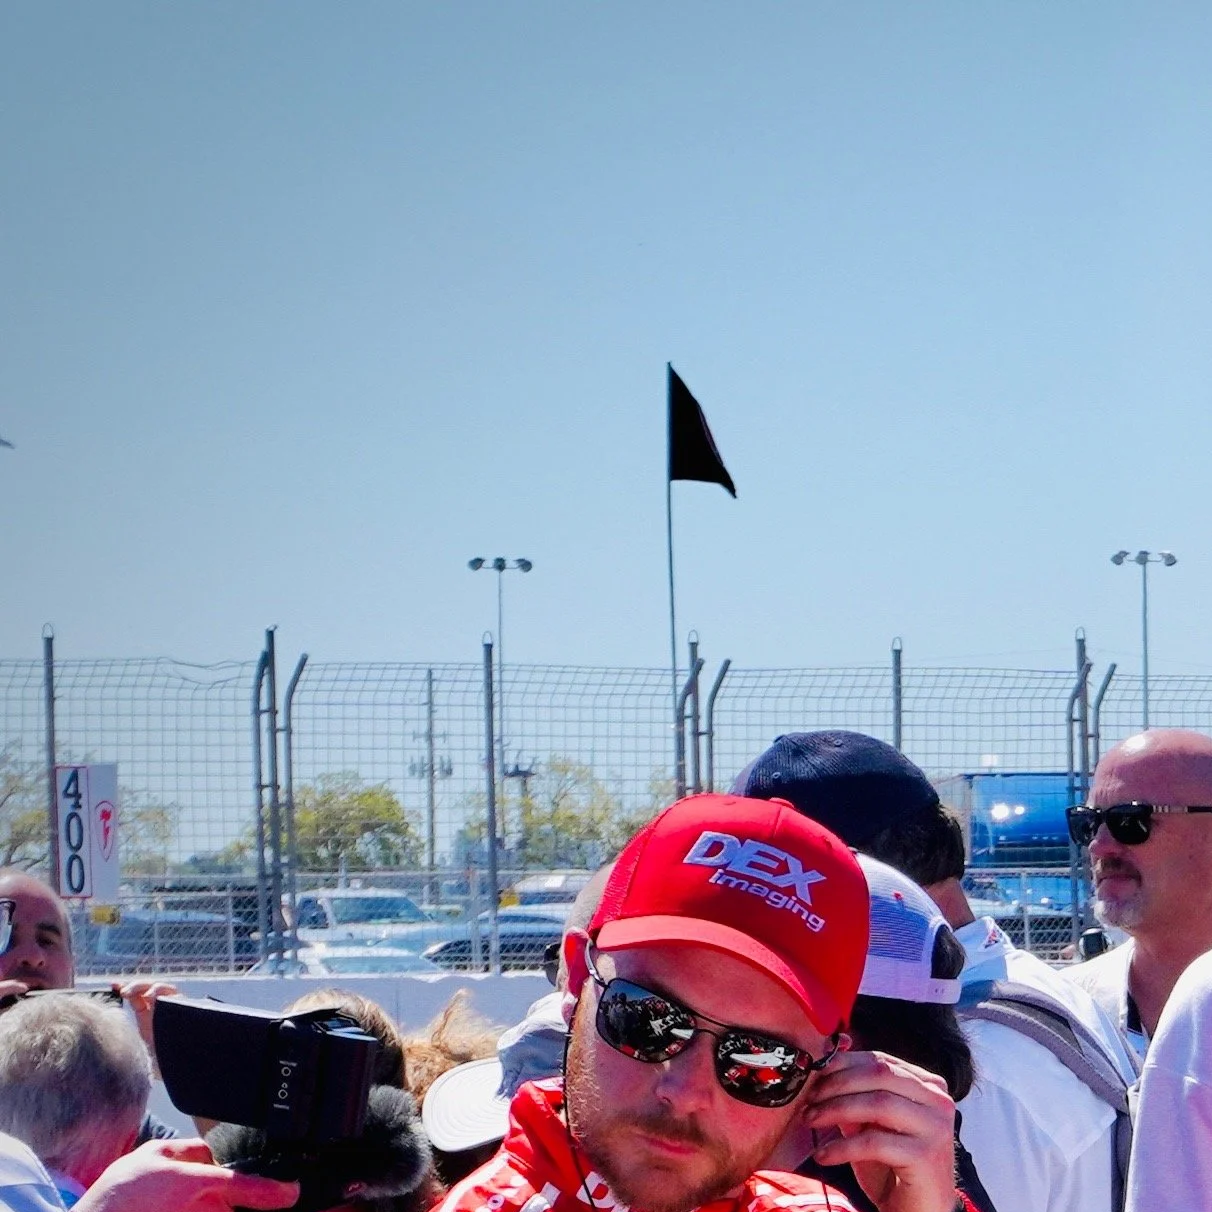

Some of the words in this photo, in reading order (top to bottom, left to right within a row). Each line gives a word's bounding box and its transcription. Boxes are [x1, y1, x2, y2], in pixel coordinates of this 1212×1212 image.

[62, 769, 84, 895] 400
[683, 830, 827, 906] DEX
[708, 869, 826, 932] imaging
